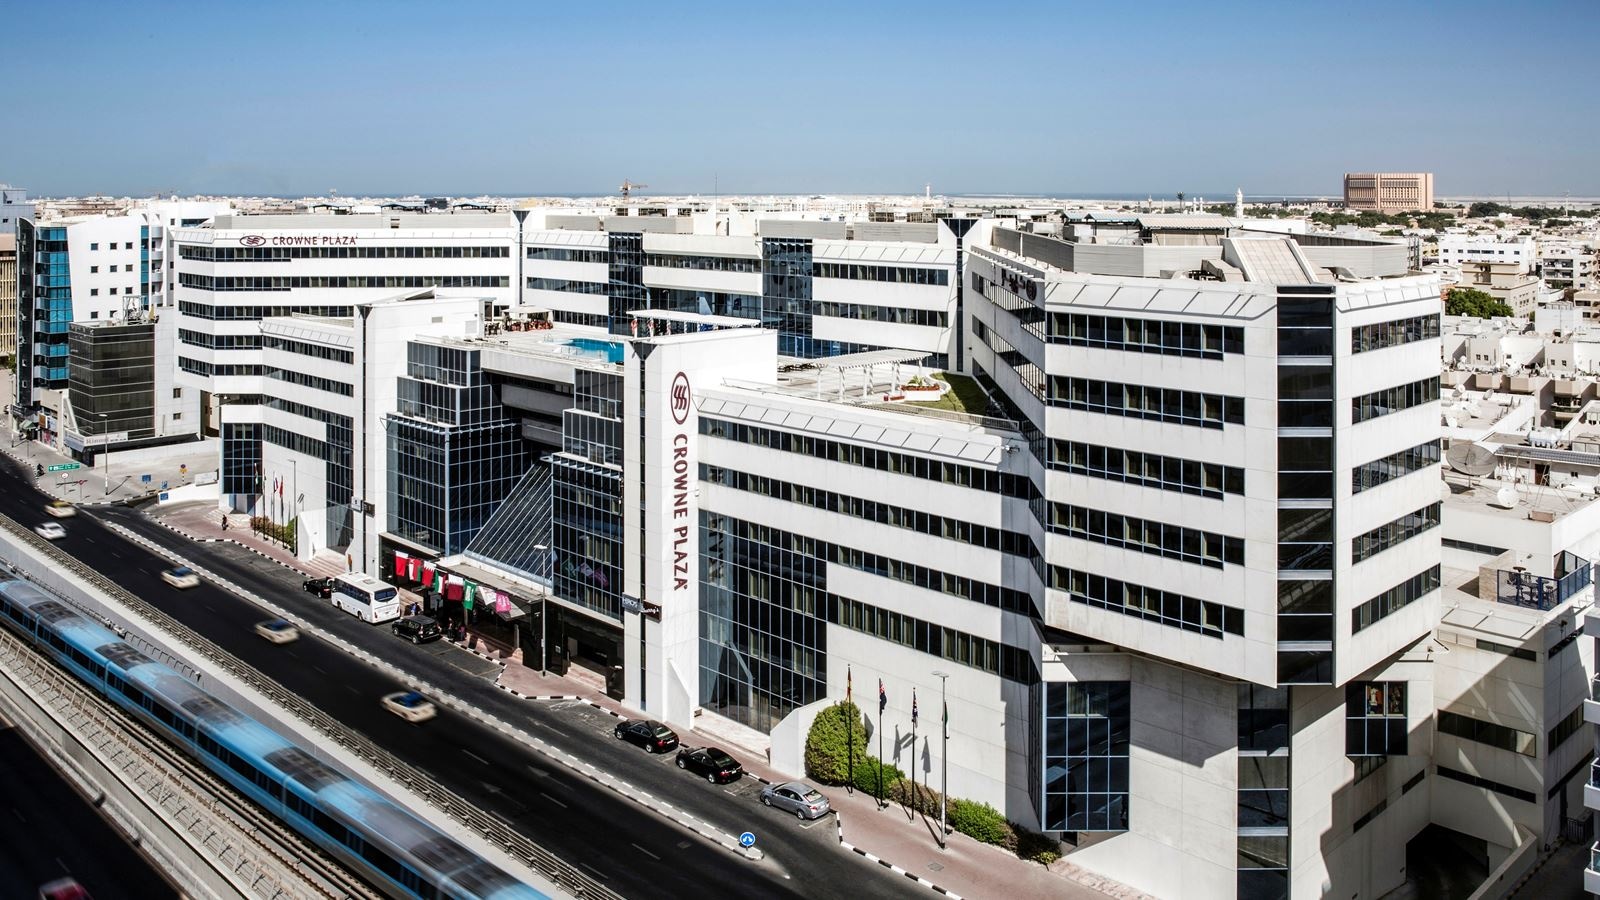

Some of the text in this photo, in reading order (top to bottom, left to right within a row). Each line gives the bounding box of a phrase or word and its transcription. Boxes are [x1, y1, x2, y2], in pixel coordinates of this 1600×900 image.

[272, 236, 356, 246] CROWNE PLAZA
[673, 433, 688, 590] CROWNE PLAZA
